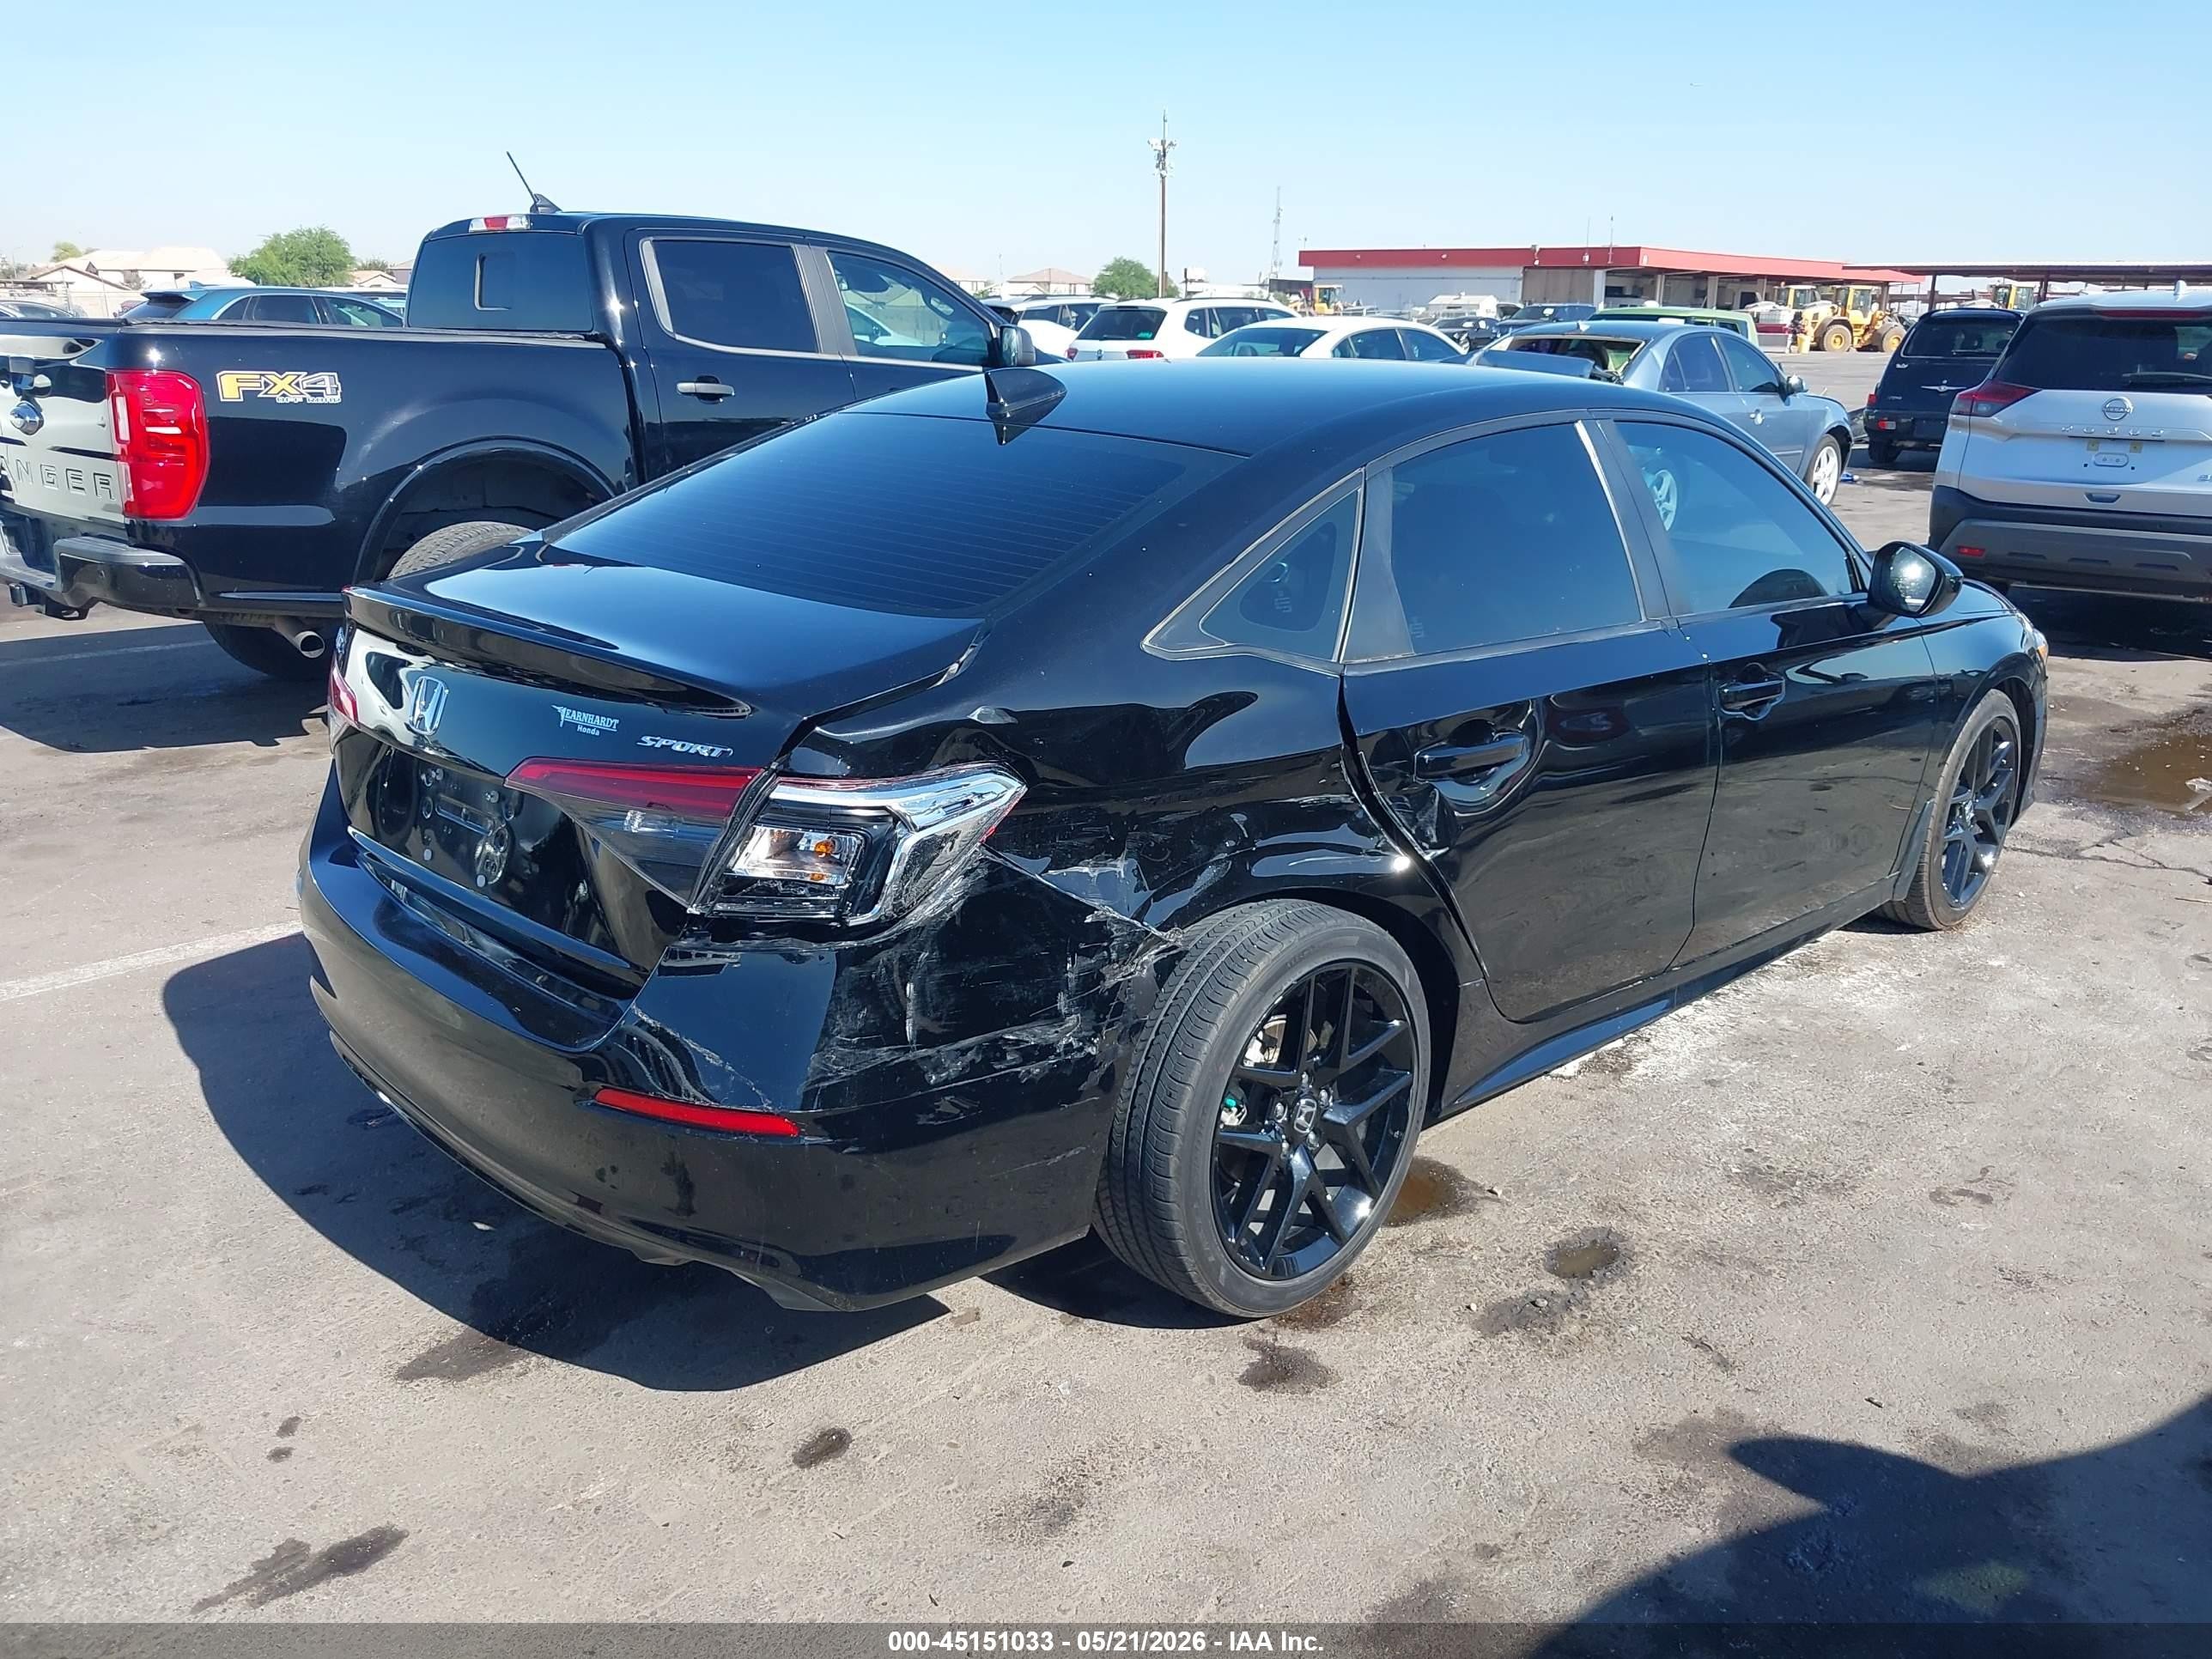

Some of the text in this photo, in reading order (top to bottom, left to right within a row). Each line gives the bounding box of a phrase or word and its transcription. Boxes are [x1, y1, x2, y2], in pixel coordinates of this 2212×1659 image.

[216, 371, 341, 402] FX4
[576, 725, 600, 736] Honda
[636, 736, 733, 757] SPORT
